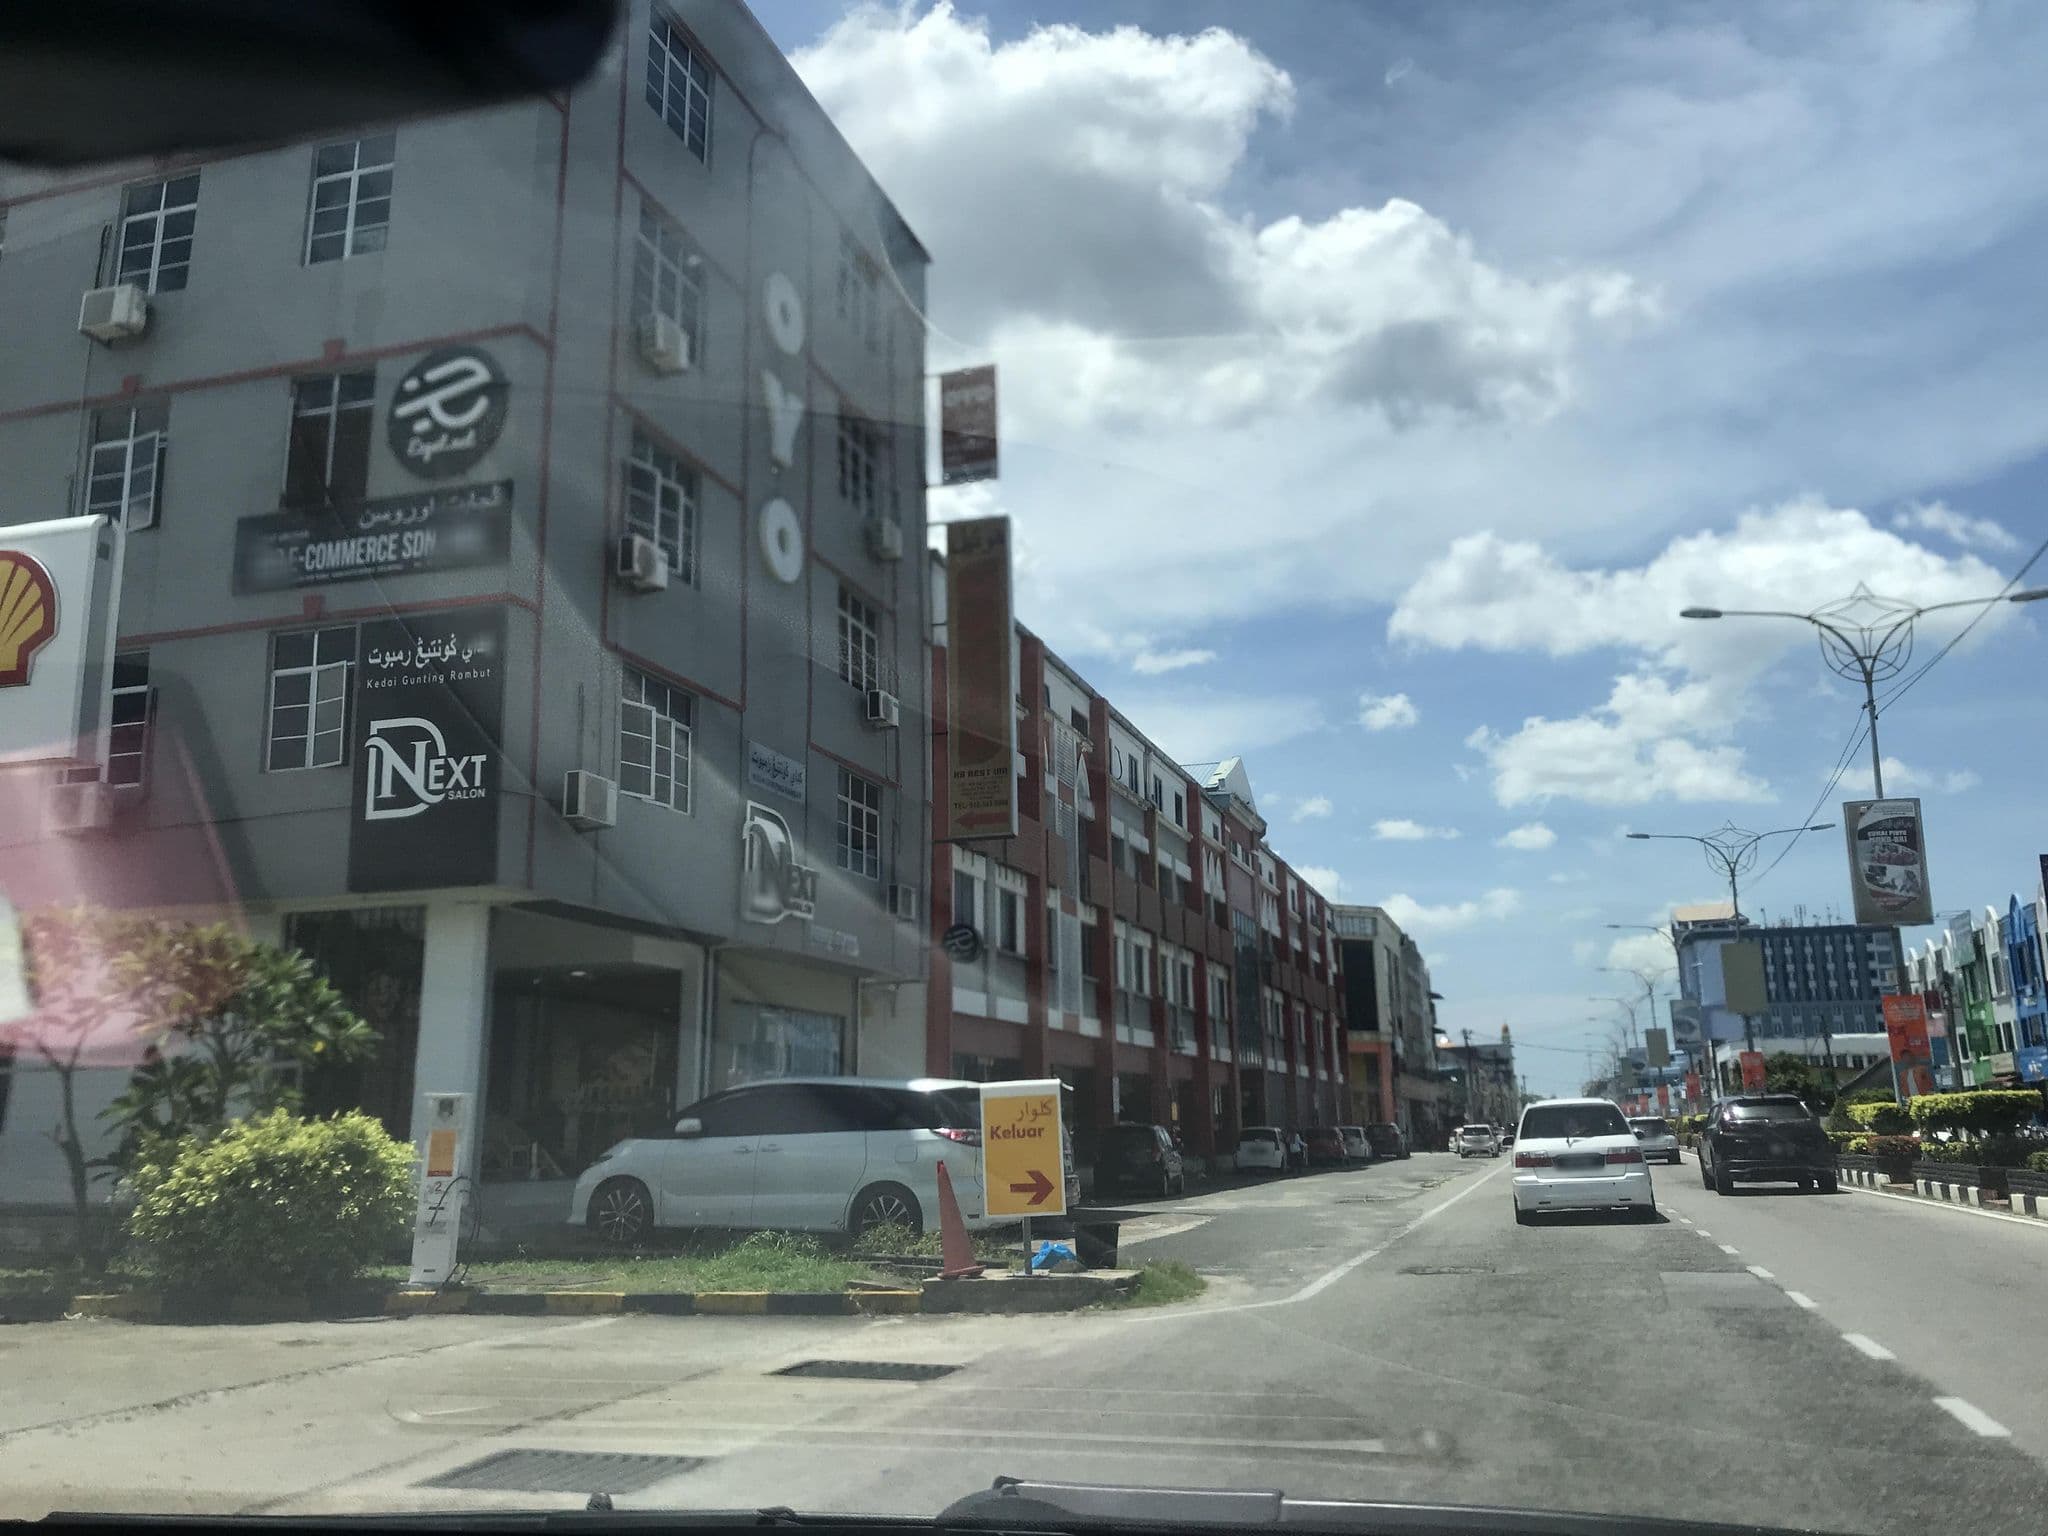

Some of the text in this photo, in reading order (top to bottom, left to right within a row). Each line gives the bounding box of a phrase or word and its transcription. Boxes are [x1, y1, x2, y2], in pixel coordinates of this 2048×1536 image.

[366, 668, 491, 689] Kedai Gunting Rambut
[447, 788, 486, 800] SALON
[990, 1124, 1045, 1140] Keluar
